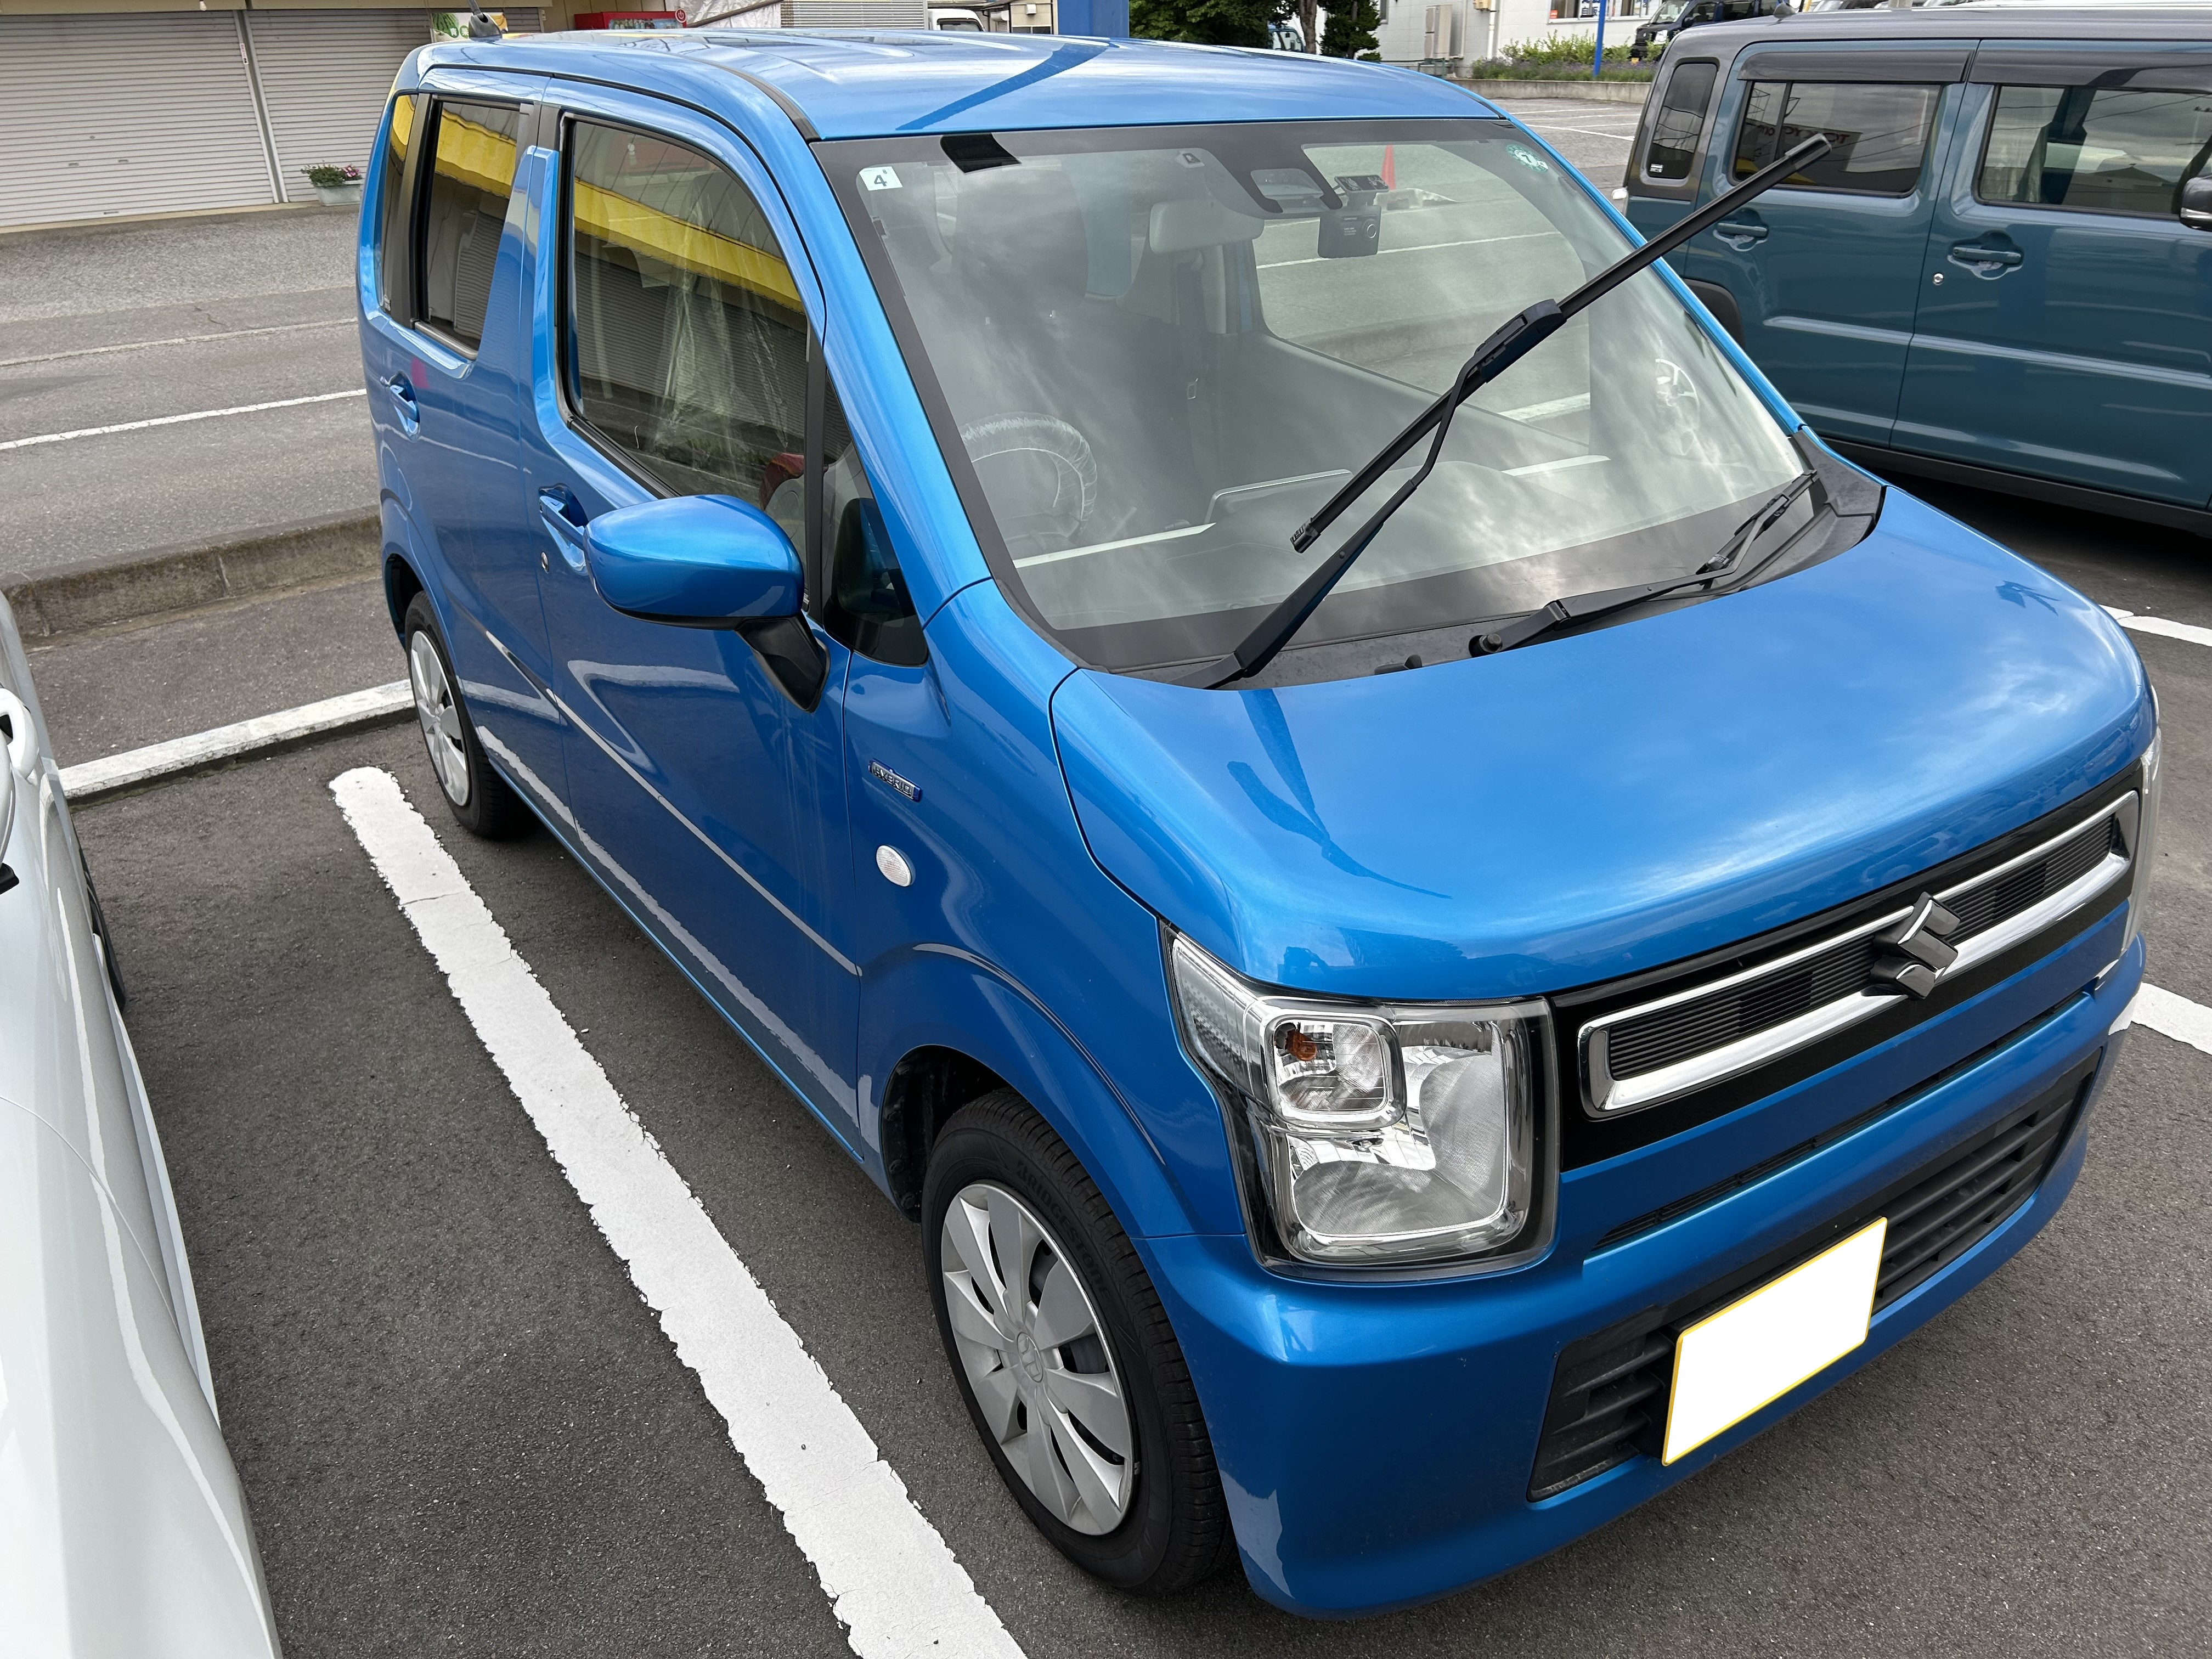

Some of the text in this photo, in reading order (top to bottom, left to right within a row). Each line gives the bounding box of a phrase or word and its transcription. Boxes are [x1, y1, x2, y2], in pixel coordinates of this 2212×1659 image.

[874, 174, 888, 187] 4
[872, 765, 913, 796] HYBRID
[1016, 1160, 1113, 1300] BRIDGESTONE
